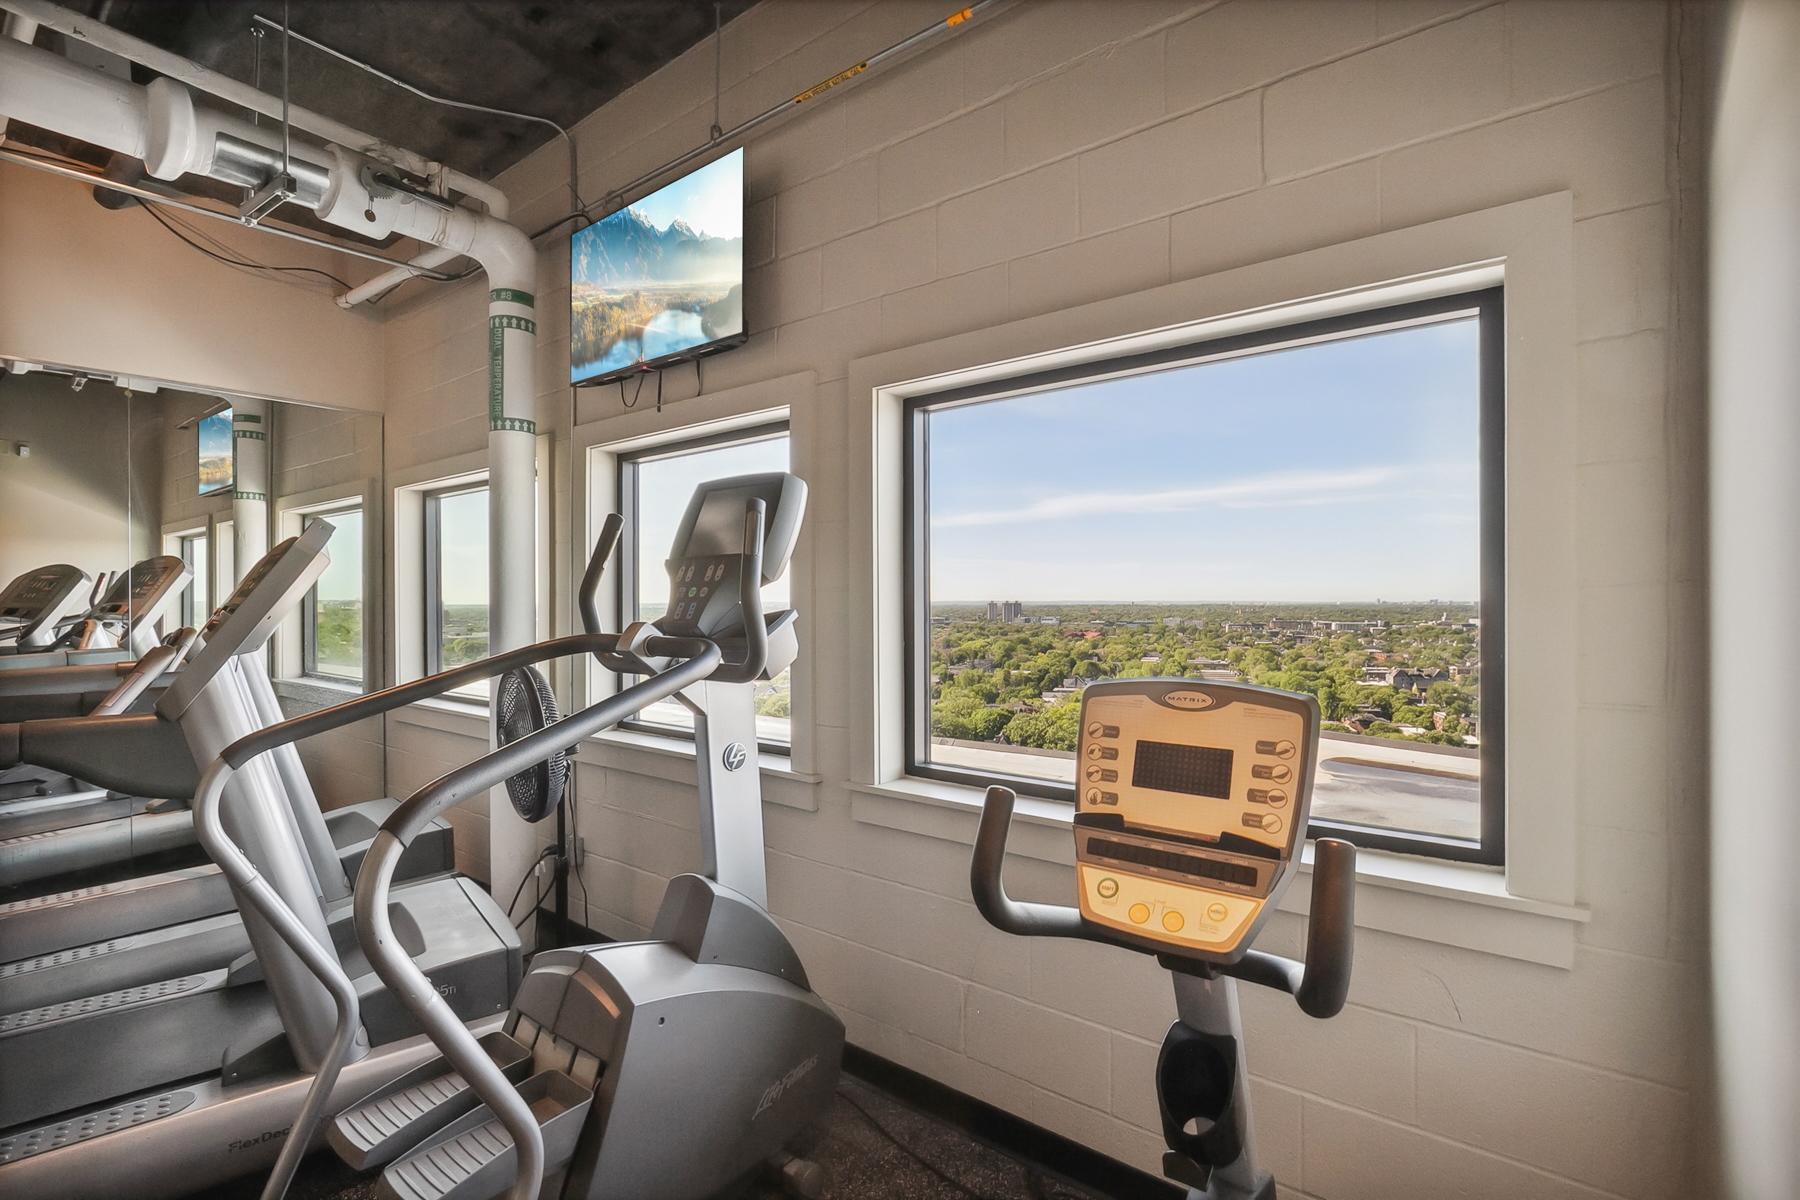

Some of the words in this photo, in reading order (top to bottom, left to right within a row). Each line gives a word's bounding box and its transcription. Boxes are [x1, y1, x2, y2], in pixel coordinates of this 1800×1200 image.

[501, 289, 512, 301] #8
[493, 328, 502, 349] DUAL
[493, 355, 502, 417] TEMPERATURE
[1167, 696, 1208, 704] MATRIX
[228, 1124, 294, 1154] FlexDec
